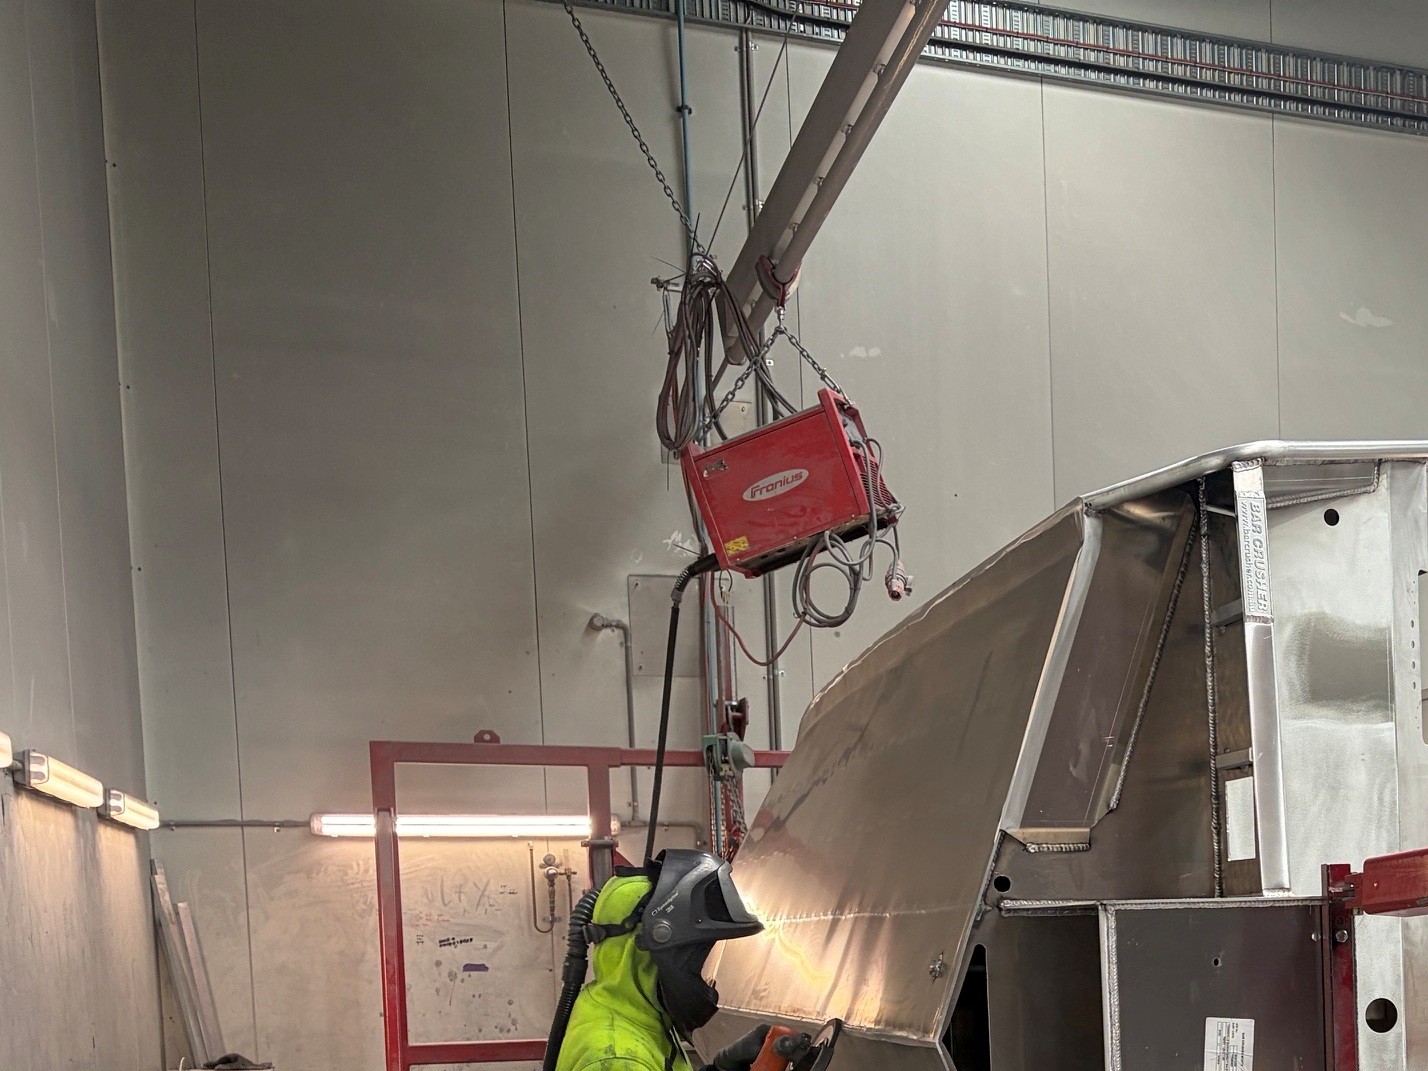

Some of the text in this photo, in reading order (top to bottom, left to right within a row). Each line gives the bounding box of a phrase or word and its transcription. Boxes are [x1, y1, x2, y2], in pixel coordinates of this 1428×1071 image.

[751, 471, 803, 499] Fronius
[1250, 502, 1268, 612] BAR CRUSHER
